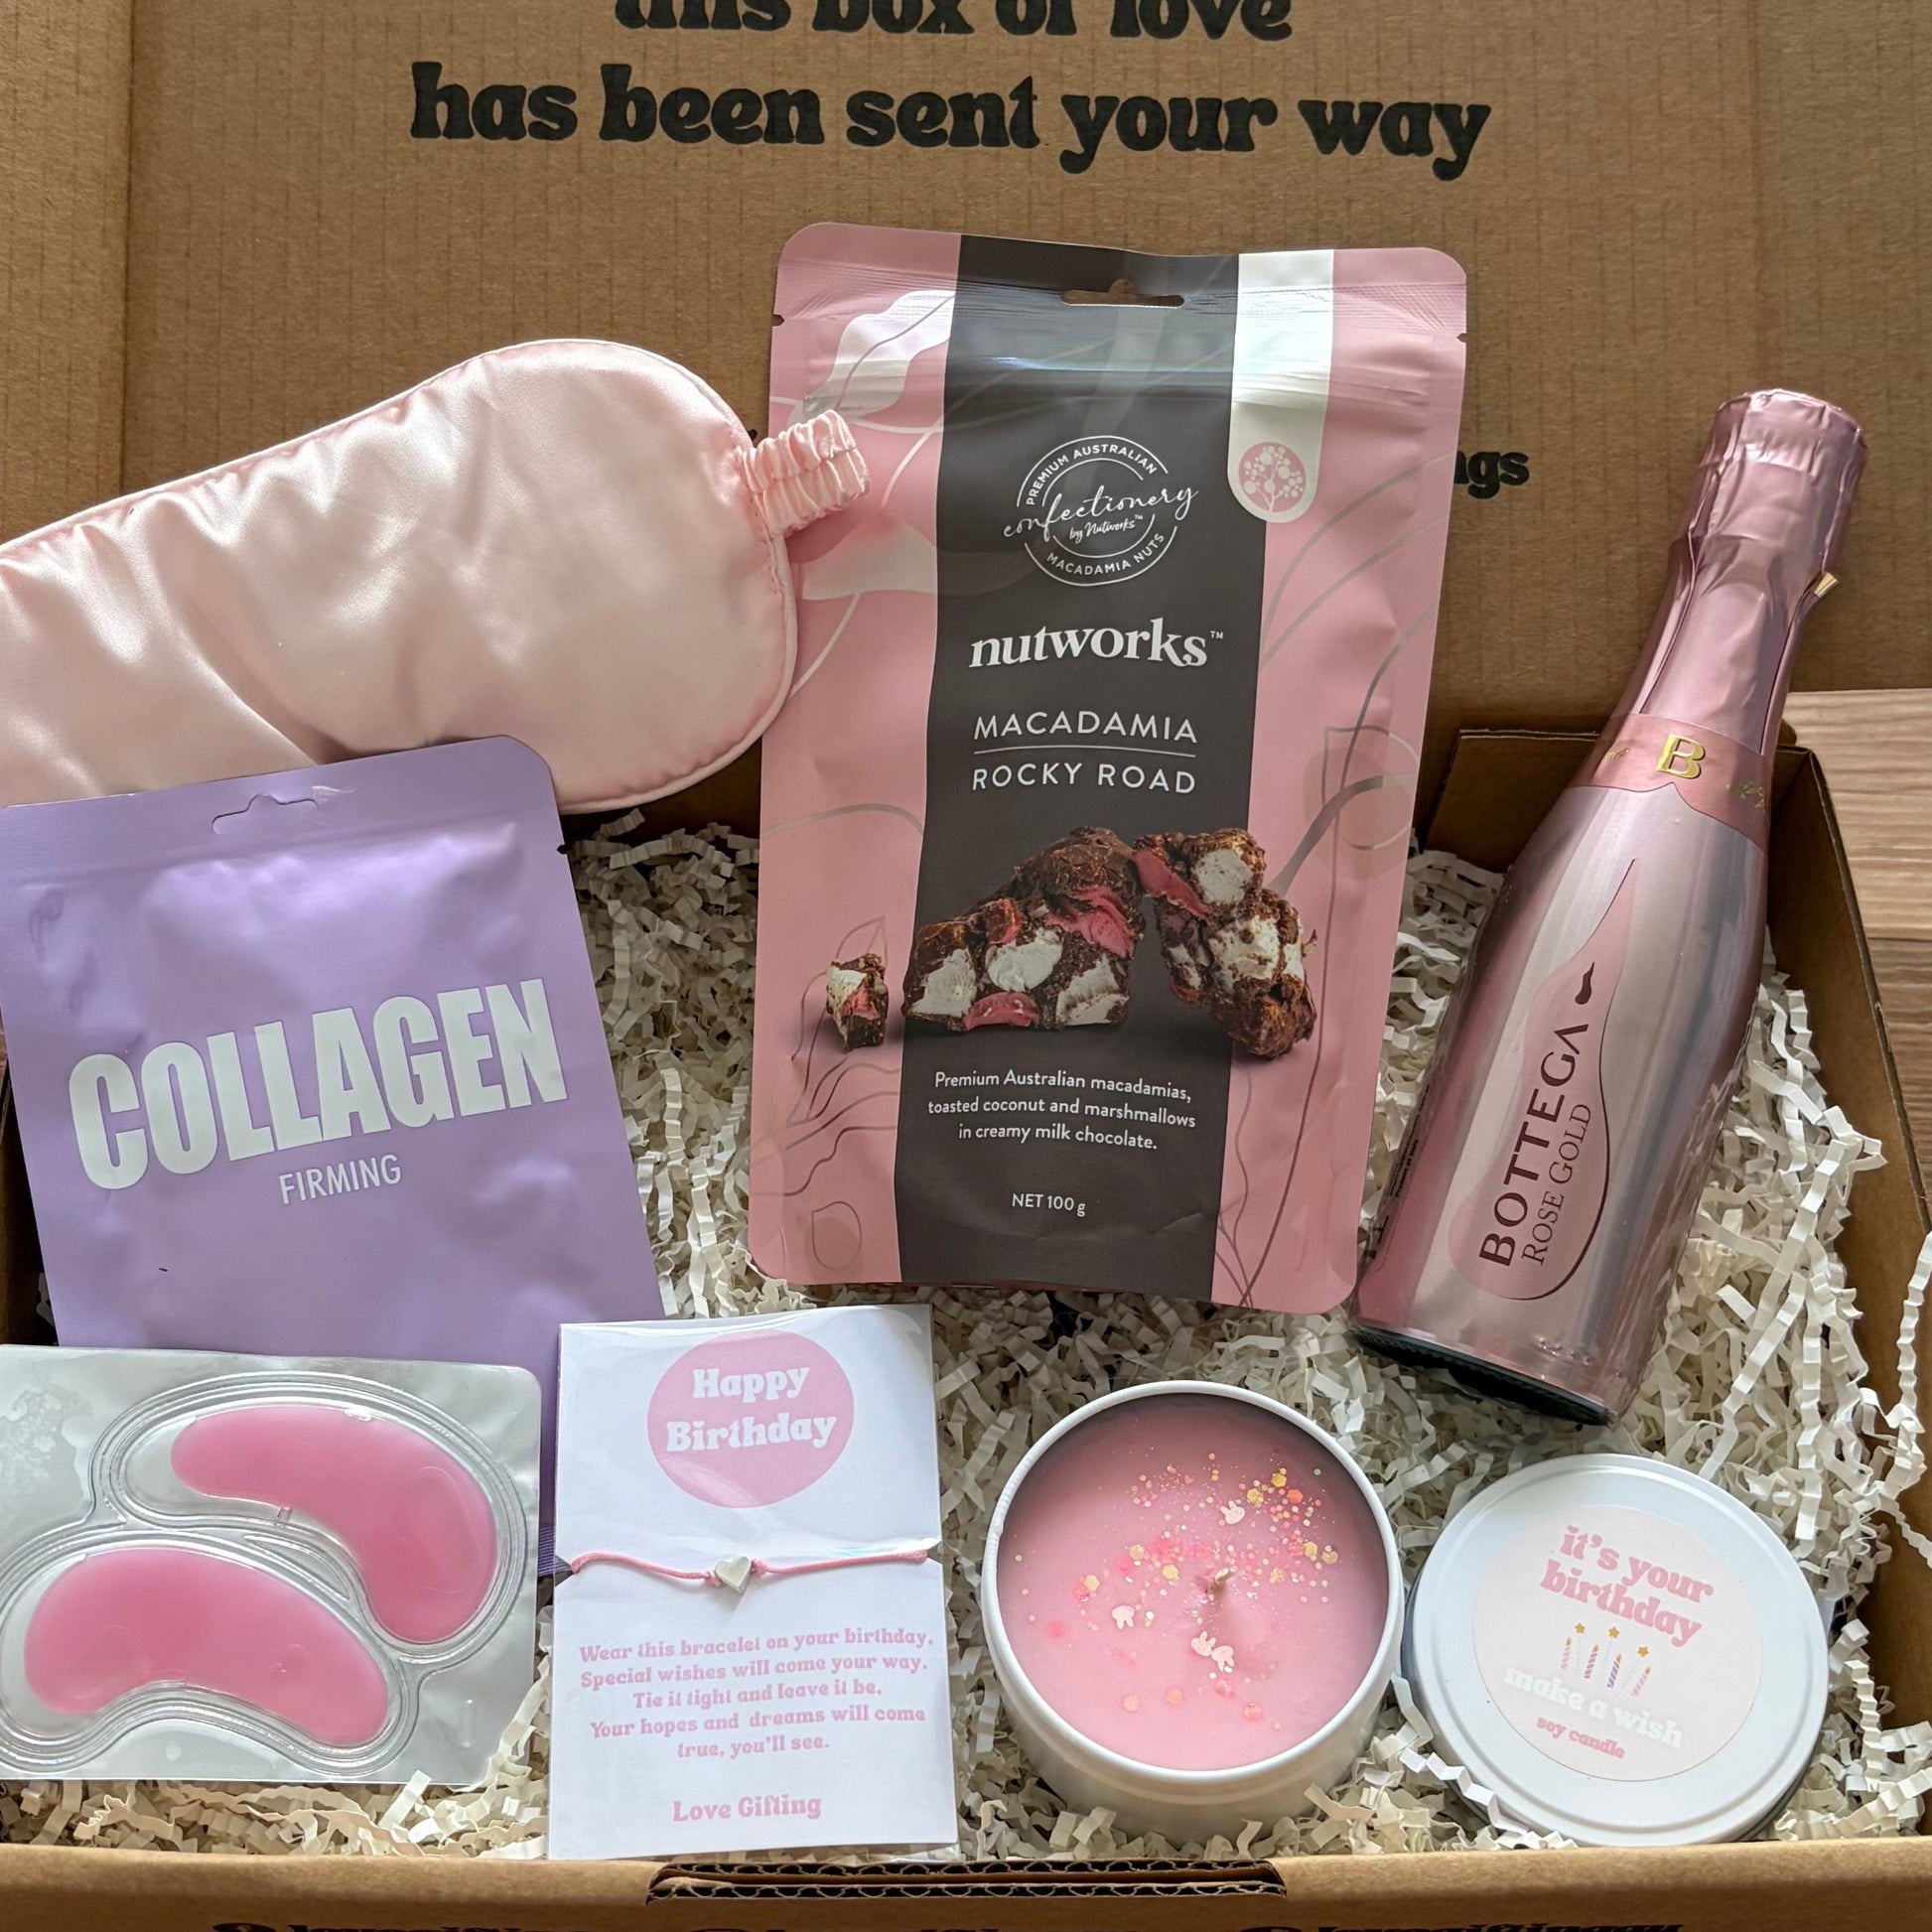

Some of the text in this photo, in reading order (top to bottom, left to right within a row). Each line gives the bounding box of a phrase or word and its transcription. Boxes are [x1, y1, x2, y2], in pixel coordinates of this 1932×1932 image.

[410, 61, 1491, 181] has been sent your way
[1026, 443, 1158, 506] PREMIUM AUSTRALIAN
[1003, 484, 1199, 542] confectionery
[1046, 531, 1166, 576] MACADAMIA NUTS
[1069, 526, 1083, 545] by
[973, 710, 1197, 744] MACADAMIA
[1656, 733, 1706, 780] B
[972, 762, 1195, 794] ROCKY ROAD
[69, 977, 569, 1190] COLLAGEN
[934, 1068, 1192, 1104] Premium Australian macadamias,
[927, 1096, 1196, 1128] toasted coconut and marshmallows
[958, 1123, 1159, 1150] in creamy milk chocolate.
[1478, 1023, 1589, 1267] BOTTEGA
[278, 1154, 402, 1205] FIRMING
[1521, 1103, 1591, 1266] ROSE GOLD
[1012, 1192, 1086, 1217] NET 100 g
[692, 1366, 810, 1404] Happy
[666, 1412, 837, 1452] Birthday
[1621, 1556, 1714, 1603] your
[1540, 1559, 1703, 1647] birthday
[580, 1645, 633, 1663] Wear
[636, 1641, 675, 1658] this
[680, 1636, 761, 1656] bracelet
[765, 1637, 789, 1649] on
[793, 1631, 840, 1651] your
[581, 1656, 928, 1692] Special wishes will come your way.
[632, 1691, 663, 1709] Tie
[667, 1691, 682, 1707] it
[686, 1688, 733, 1710] tight
[737, 1684, 773, 1703] and
[777, 1682, 829, 1700] leave
[833, 1679, 848, 1696] it
[1502, 1668, 1684, 1748] make a wish
[590, 1704, 926, 1738] Your hopes and dreams will come
[1536, 1717, 1626, 1760] soy candle
[730, 1734, 786, 1760] you'll
[790, 1736, 830, 1750] see.
[672, 1794, 822, 1823] Love Gifting
